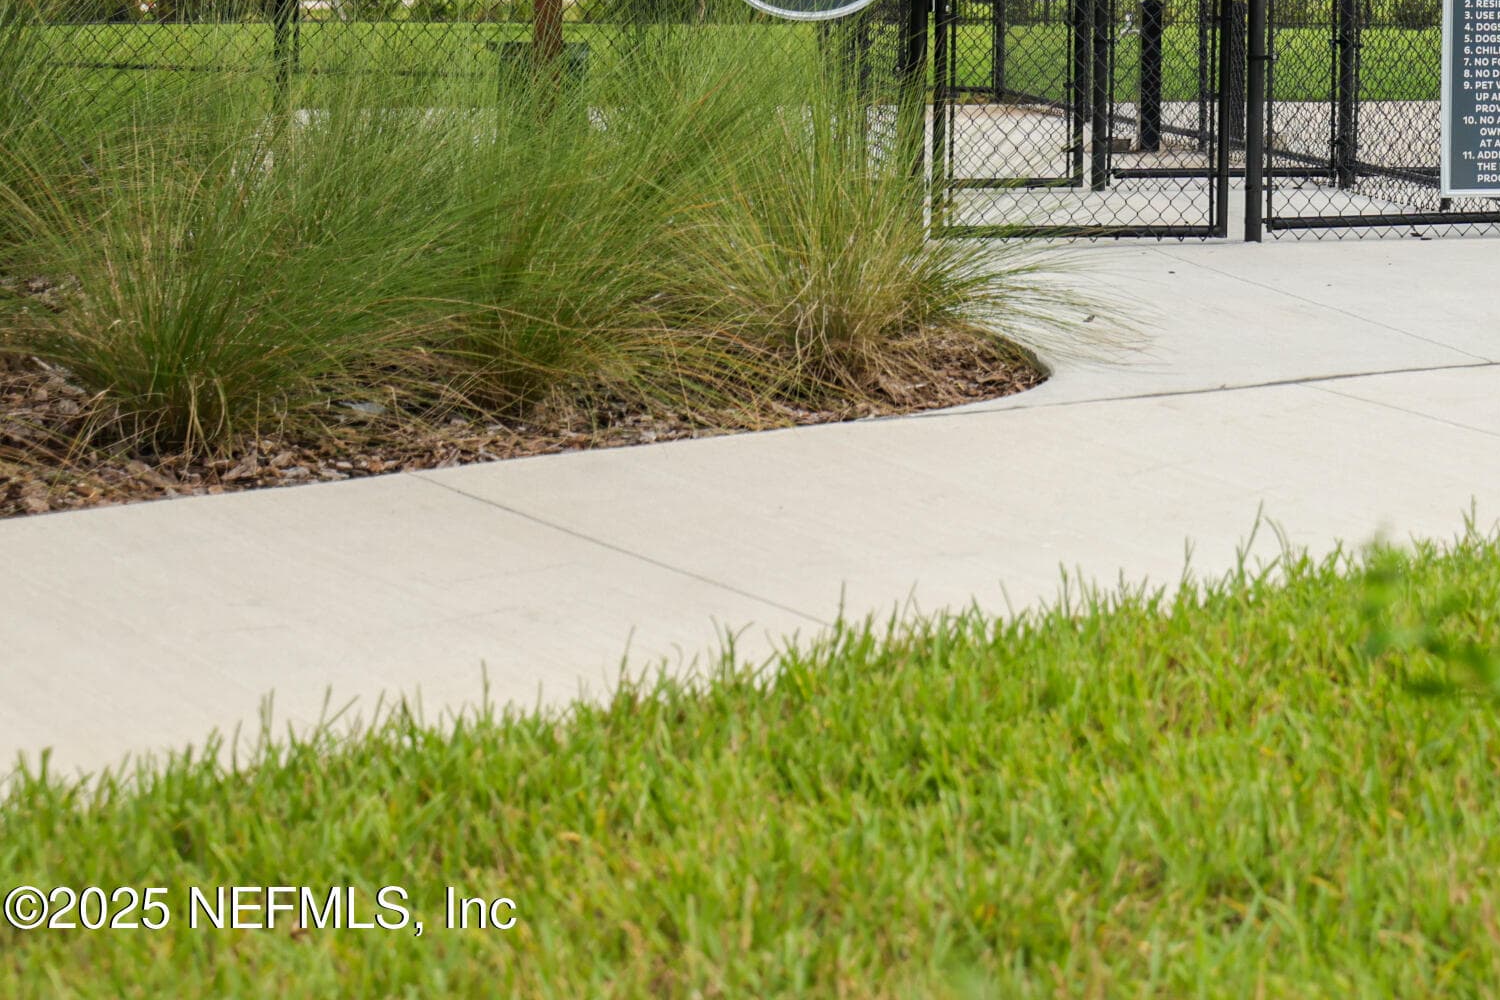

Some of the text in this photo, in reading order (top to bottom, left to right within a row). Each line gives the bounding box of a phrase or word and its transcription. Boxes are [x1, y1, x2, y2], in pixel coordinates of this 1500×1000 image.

[1465, 0, 1473, 8] 2.
[1465, 11, 1473, 19] 3.
[1476, 11, 1494, 20] USE
[1464, 46, 1473, 54] 6.
[1464, 58, 1471, 66] 7.
[1474, 58, 1489, 66] NO
[1464, 69, 1472, 78] 8.
[1464, 81, 1472, 89] 9.
[1476, 81, 1493, 89] PET
[1476, 92, 1489, 101] UP
[1463, 116, 1477, 124] 10.
[1480, 116, 1494, 124] NO
[1480, 139, 1492, 148] AT
[1477, 162, 1496, 170] THE
